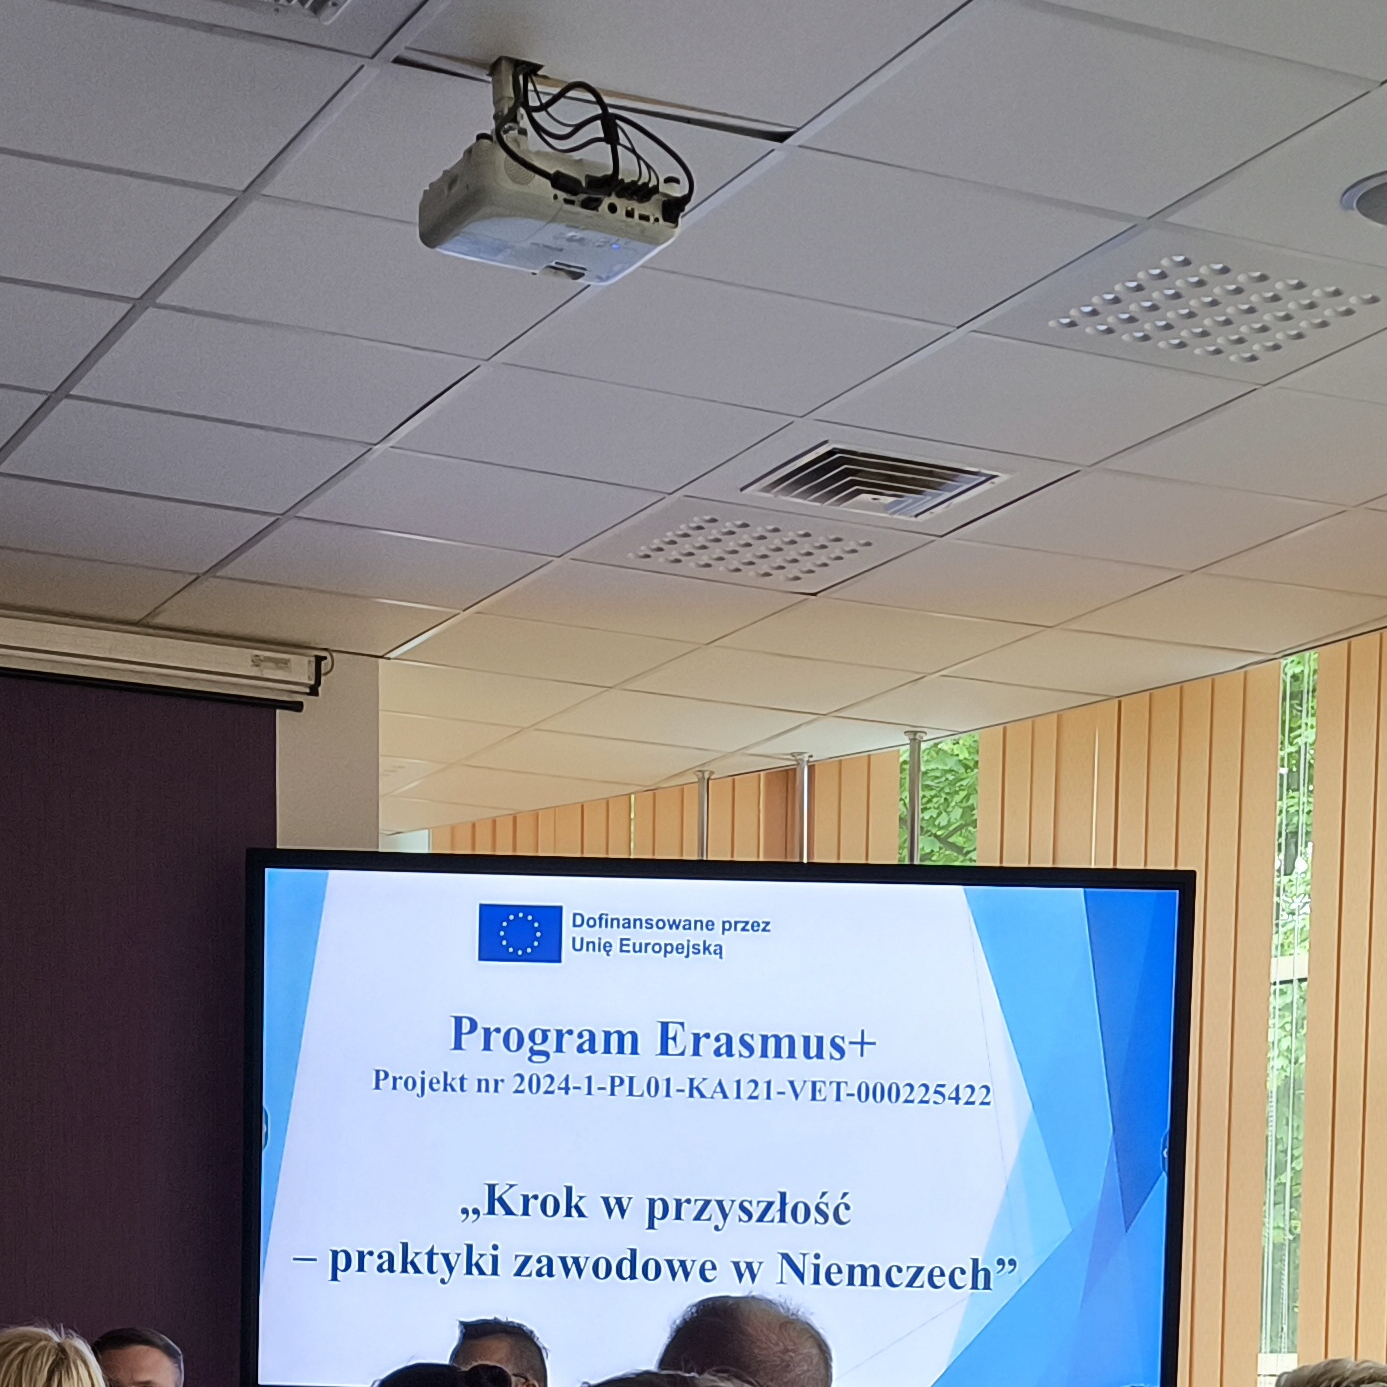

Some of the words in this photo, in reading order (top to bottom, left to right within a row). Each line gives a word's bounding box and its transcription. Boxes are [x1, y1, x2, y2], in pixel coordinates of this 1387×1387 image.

[571, 912, 715, 931] Dofinansowane
[721, 917, 771, 935] przez
[571, 936, 613, 956] Unię
[619, 937, 724, 959] Europejską
[449, 1014, 640, 1063] Program
[655, 1019, 877, 1061] Erasmus+
[372, 1068, 469, 1099] Projekt
[476, 1076, 505, 1094] nr
[512, 1072, 992, 1107] 2024-1-PL01-KA121-VET-000225422
[600, 1194, 633, 1220] w
[645, 1190, 852, 1232] przyszłość
[328, 1241, 501, 1285] praktyki
[512, 1247, 718, 1284] zawodowe
[730, 1259, 764, 1285] w
